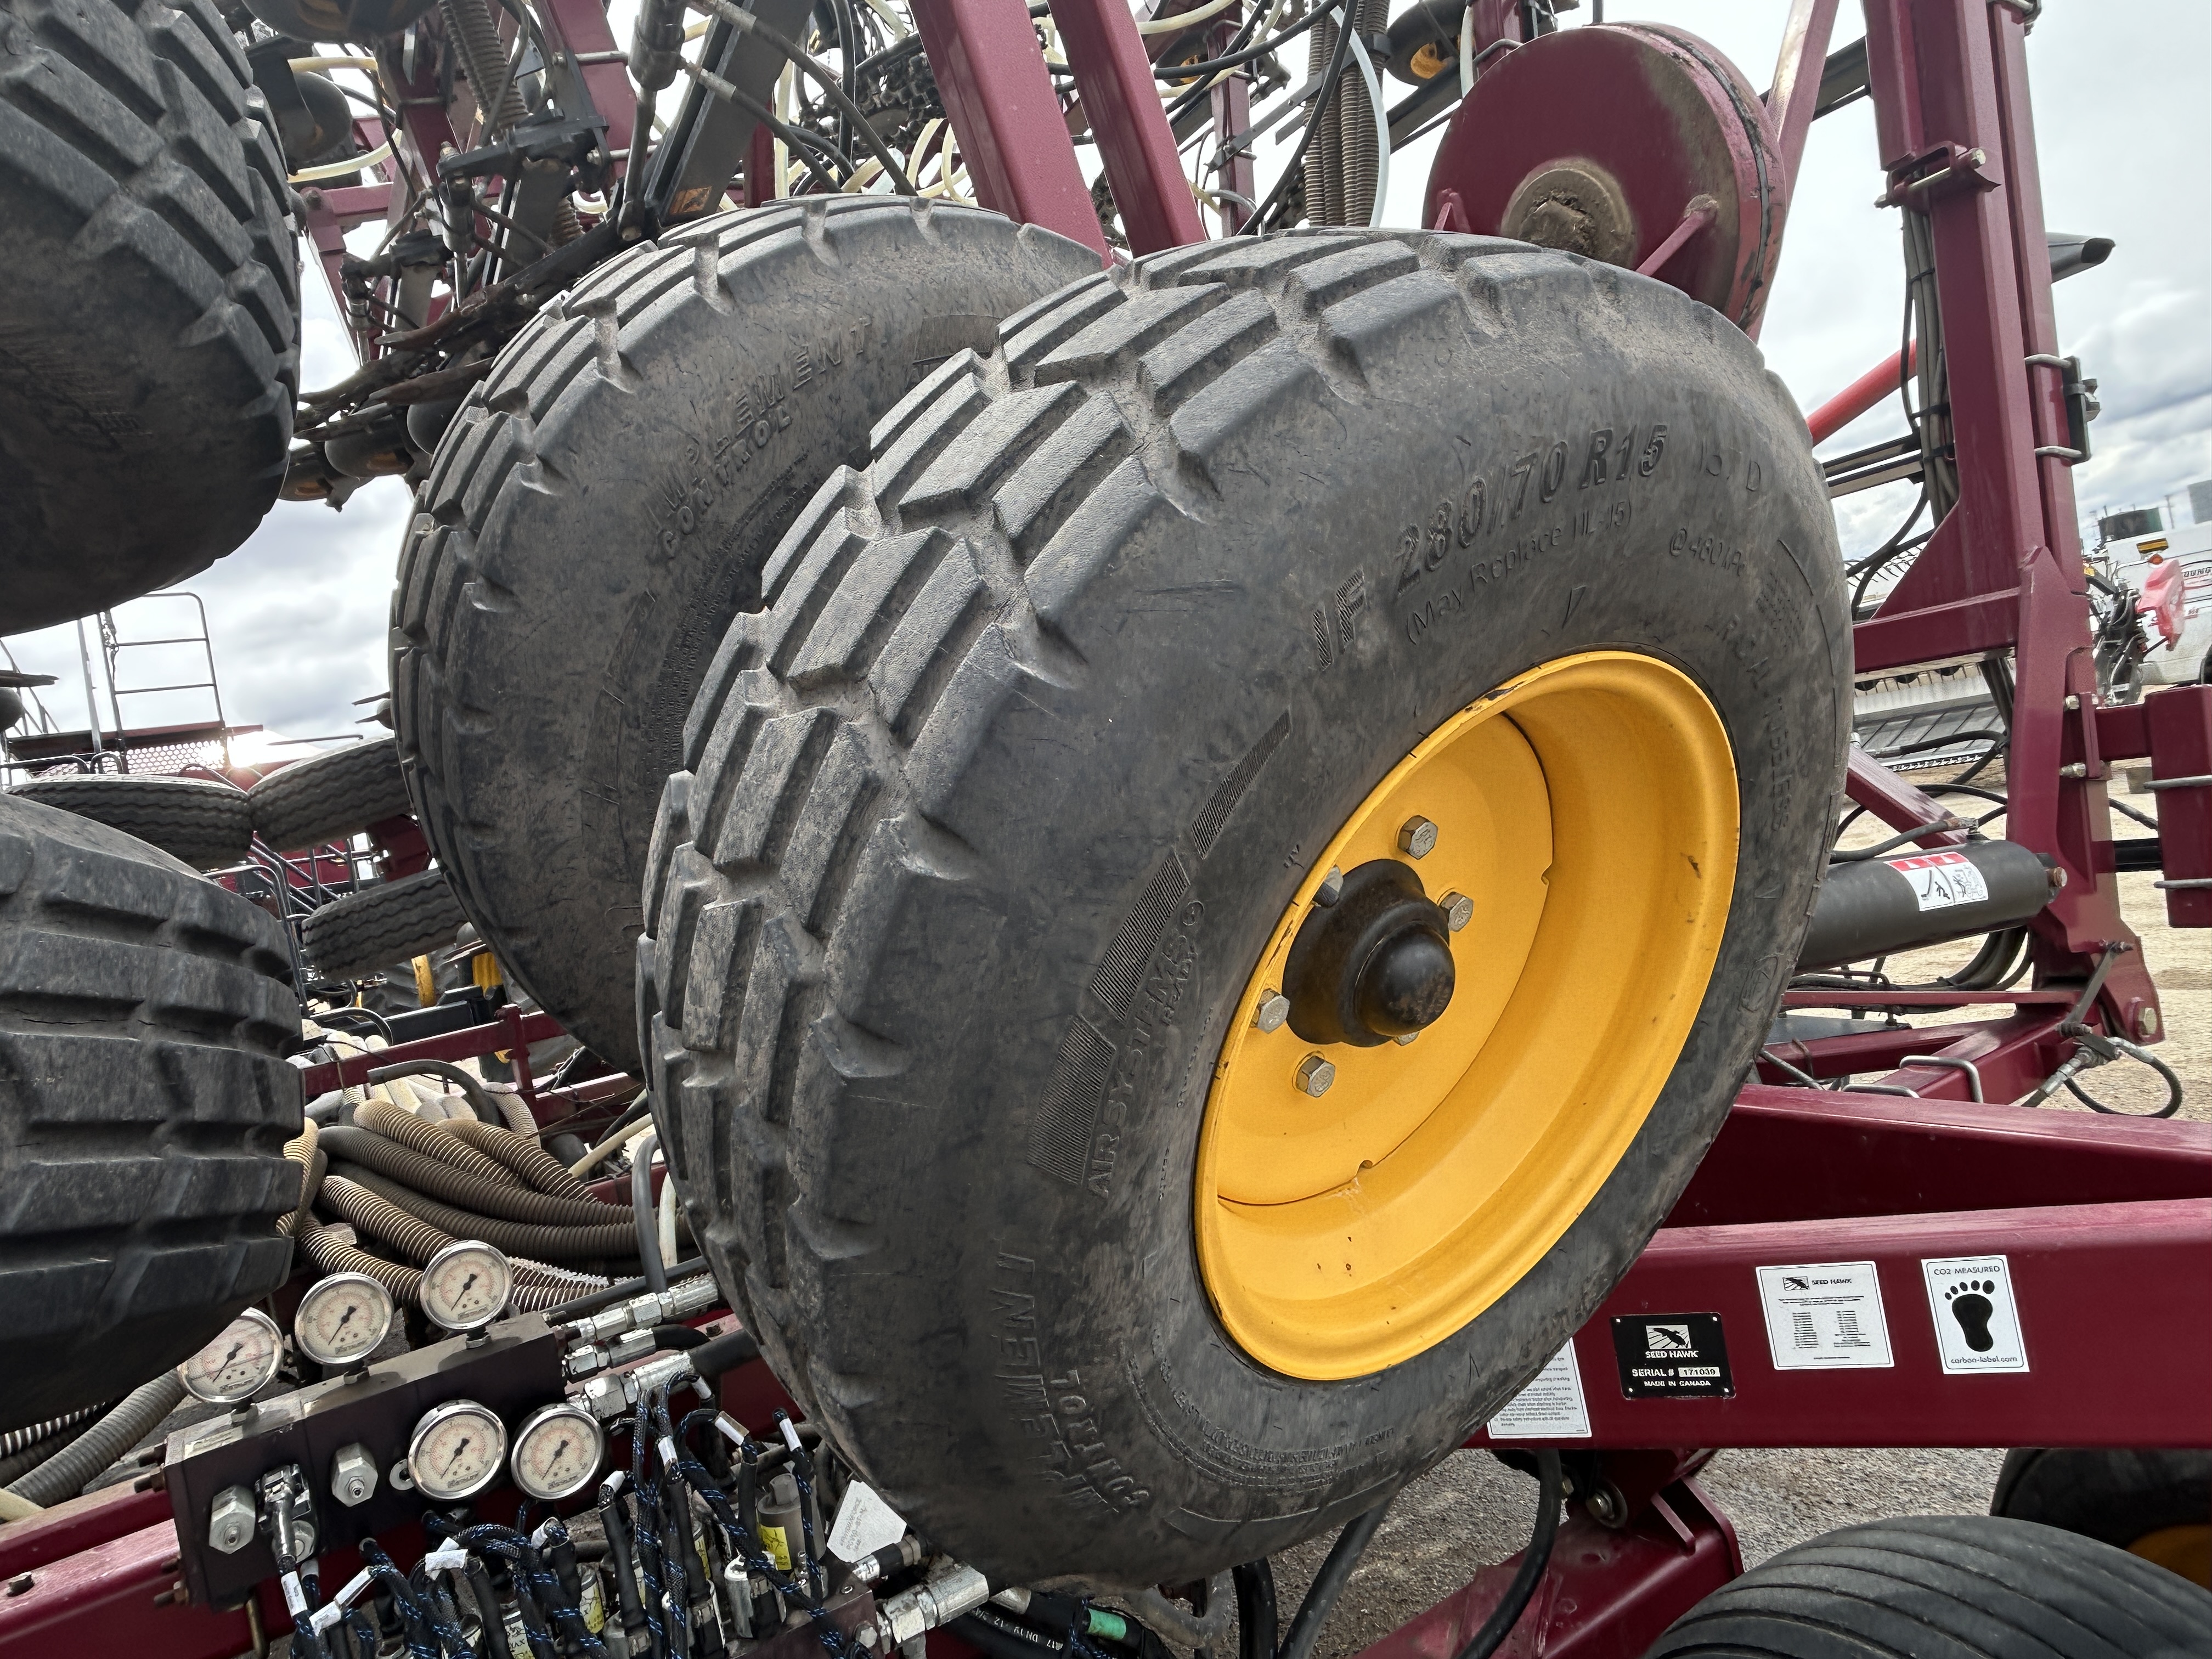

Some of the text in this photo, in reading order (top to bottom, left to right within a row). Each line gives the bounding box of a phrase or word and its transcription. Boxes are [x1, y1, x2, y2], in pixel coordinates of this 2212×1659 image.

[658, 404, 792, 558] CONTROL
[1396, 440, 1568, 594] 280/70
[1582, 424, 1668, 489] R15
[1471, 525, 1564, 594] Replace
[1954, 1266, 2001, 1274] MEASURED
[1645, 1351, 1668, 1359] SEED
[1950, 1356, 2018, 1364] carbon-label.com
[1632, 1368, 1667, 1377] SERIAL
